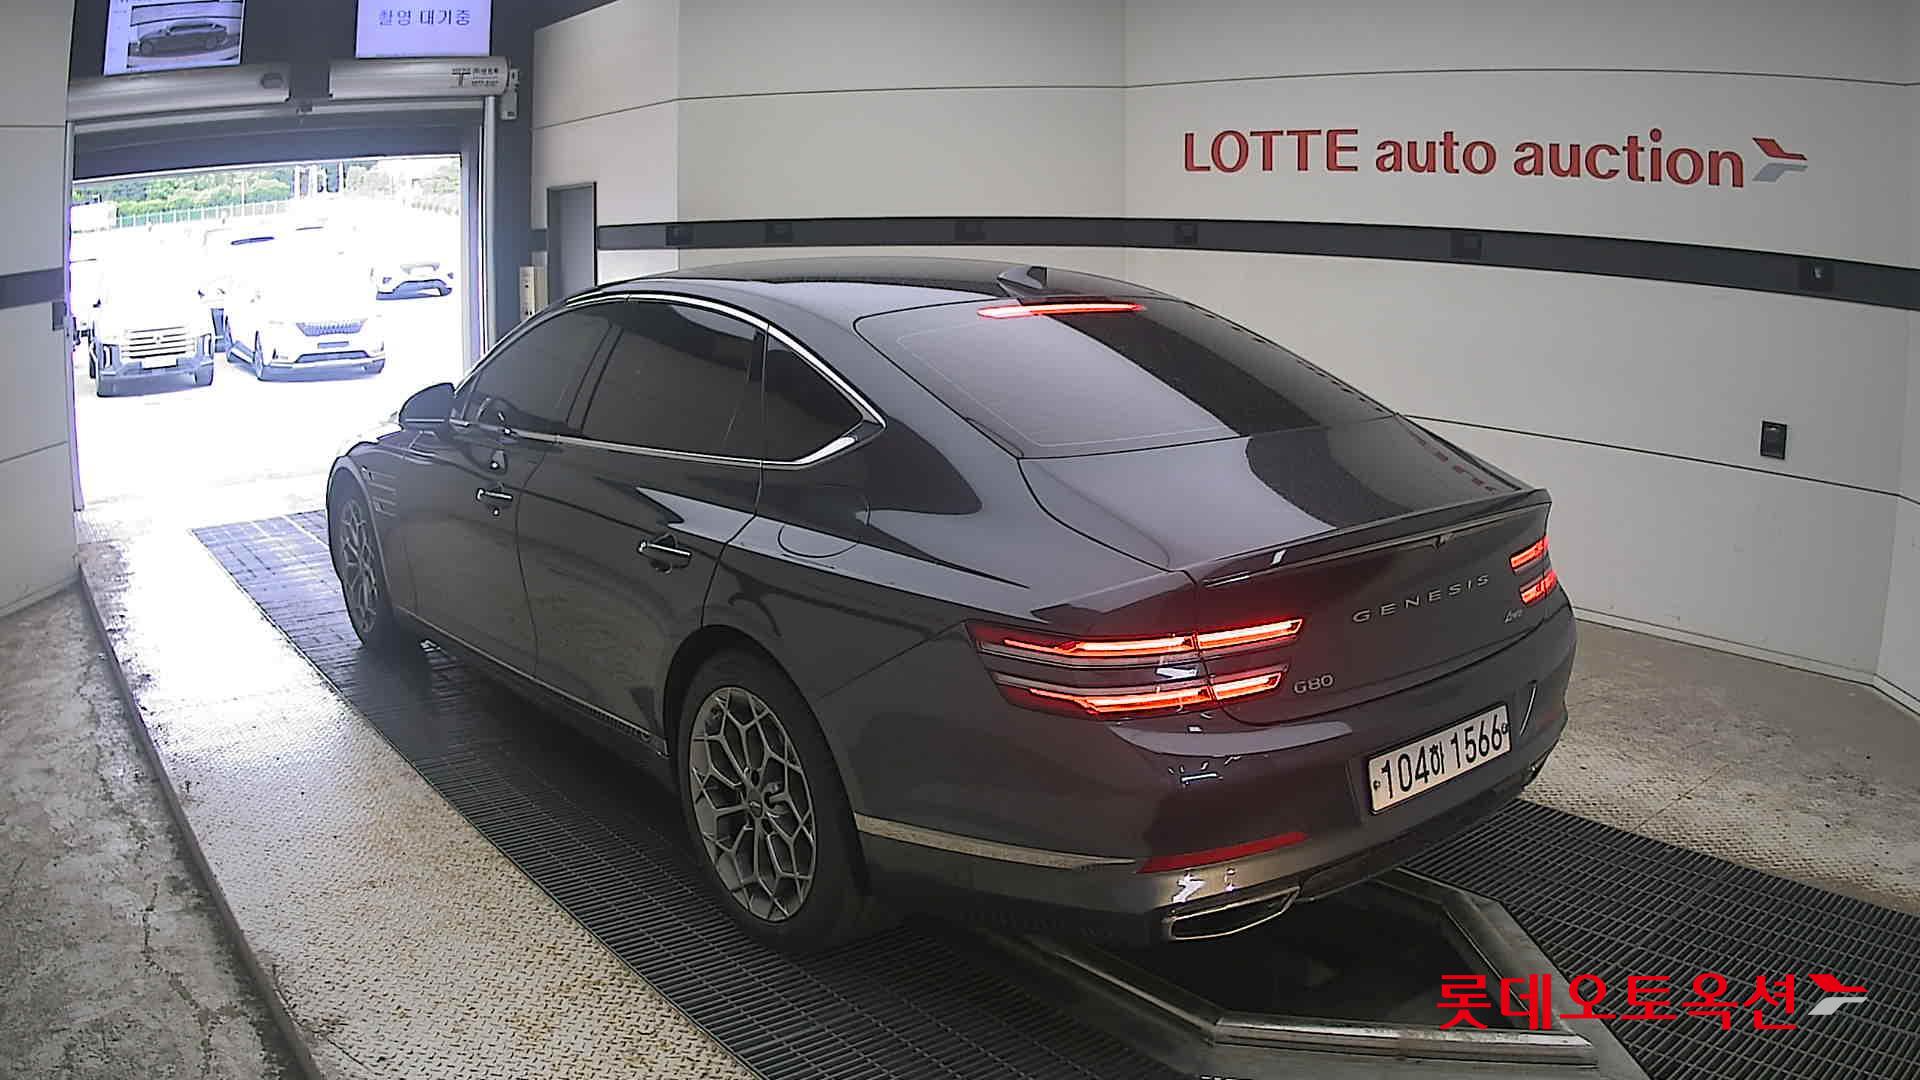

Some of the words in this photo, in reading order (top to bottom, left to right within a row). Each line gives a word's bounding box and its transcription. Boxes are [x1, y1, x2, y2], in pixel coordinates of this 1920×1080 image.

[420, 9, 471, 26] 대기중
[1184, 129, 1359, 173] LOTTE
[1375, 131, 1497, 174] auto
[1513, 128, 1744, 188] auction
[1352, 574, 1489, 623] GENESIS
[1294, 673, 1334, 694] G80
[1381, 741, 1445, 799] 104하
[1450, 714, 1503, 768] 1566
